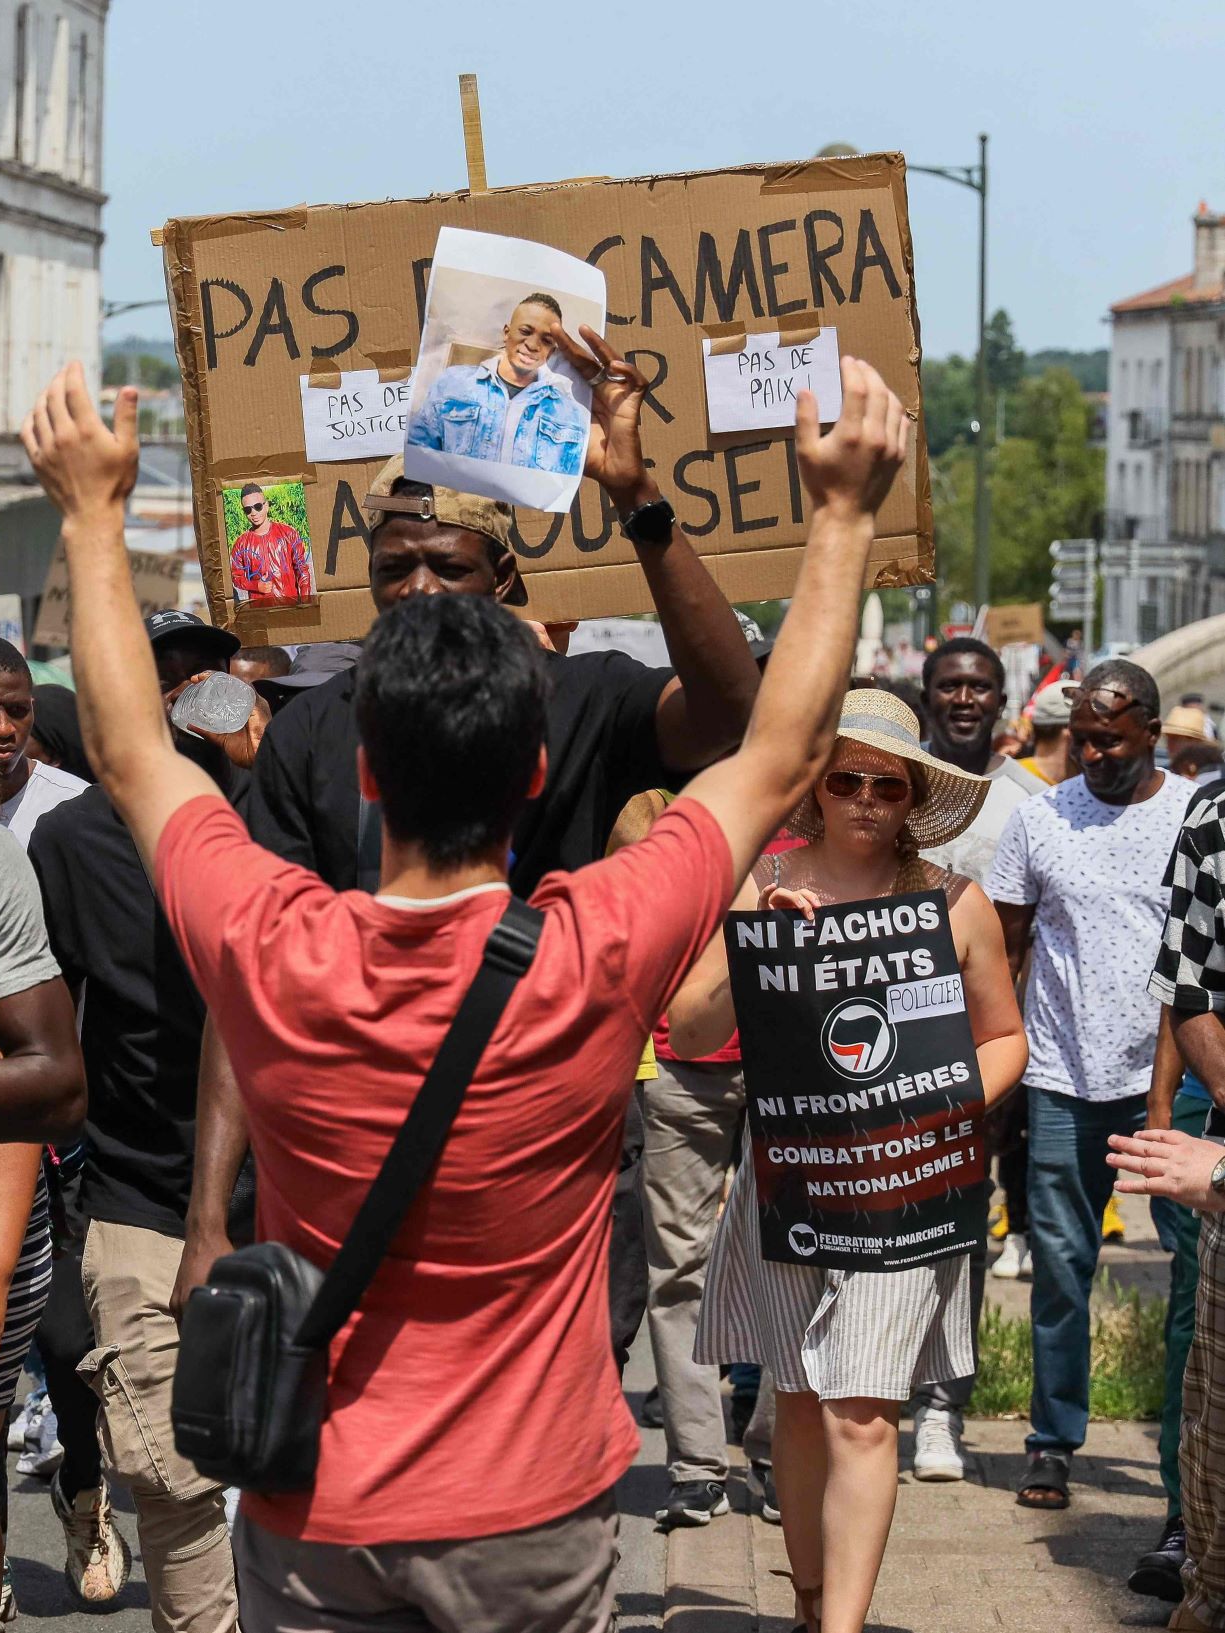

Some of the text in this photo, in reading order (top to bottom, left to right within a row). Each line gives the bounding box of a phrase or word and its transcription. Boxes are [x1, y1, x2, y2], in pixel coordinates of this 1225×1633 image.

[200, 265, 360, 371] PAS
[586, 209, 903, 328] CAMERA
[738, 348, 814, 376] PAS DE
[328, 386, 410, 419] PAS DE
[749, 376, 796, 409] PAIX
[326, 414, 407, 441] JUSTICE
[736, 901, 940, 949] NI FACHOS
[758, 948, 935, 992] NI ÉTATS
[889, 979, 963, 1015] POLICIER
[757, 1061, 970, 1117] NI FRONTIÈRES
[768, 1120, 973, 1164] COMBATTONS LE
[807, 1147, 976, 1196] NATIONALISME !
[820, 1222, 956, 1249] FEDERATION ANARCHISTE
